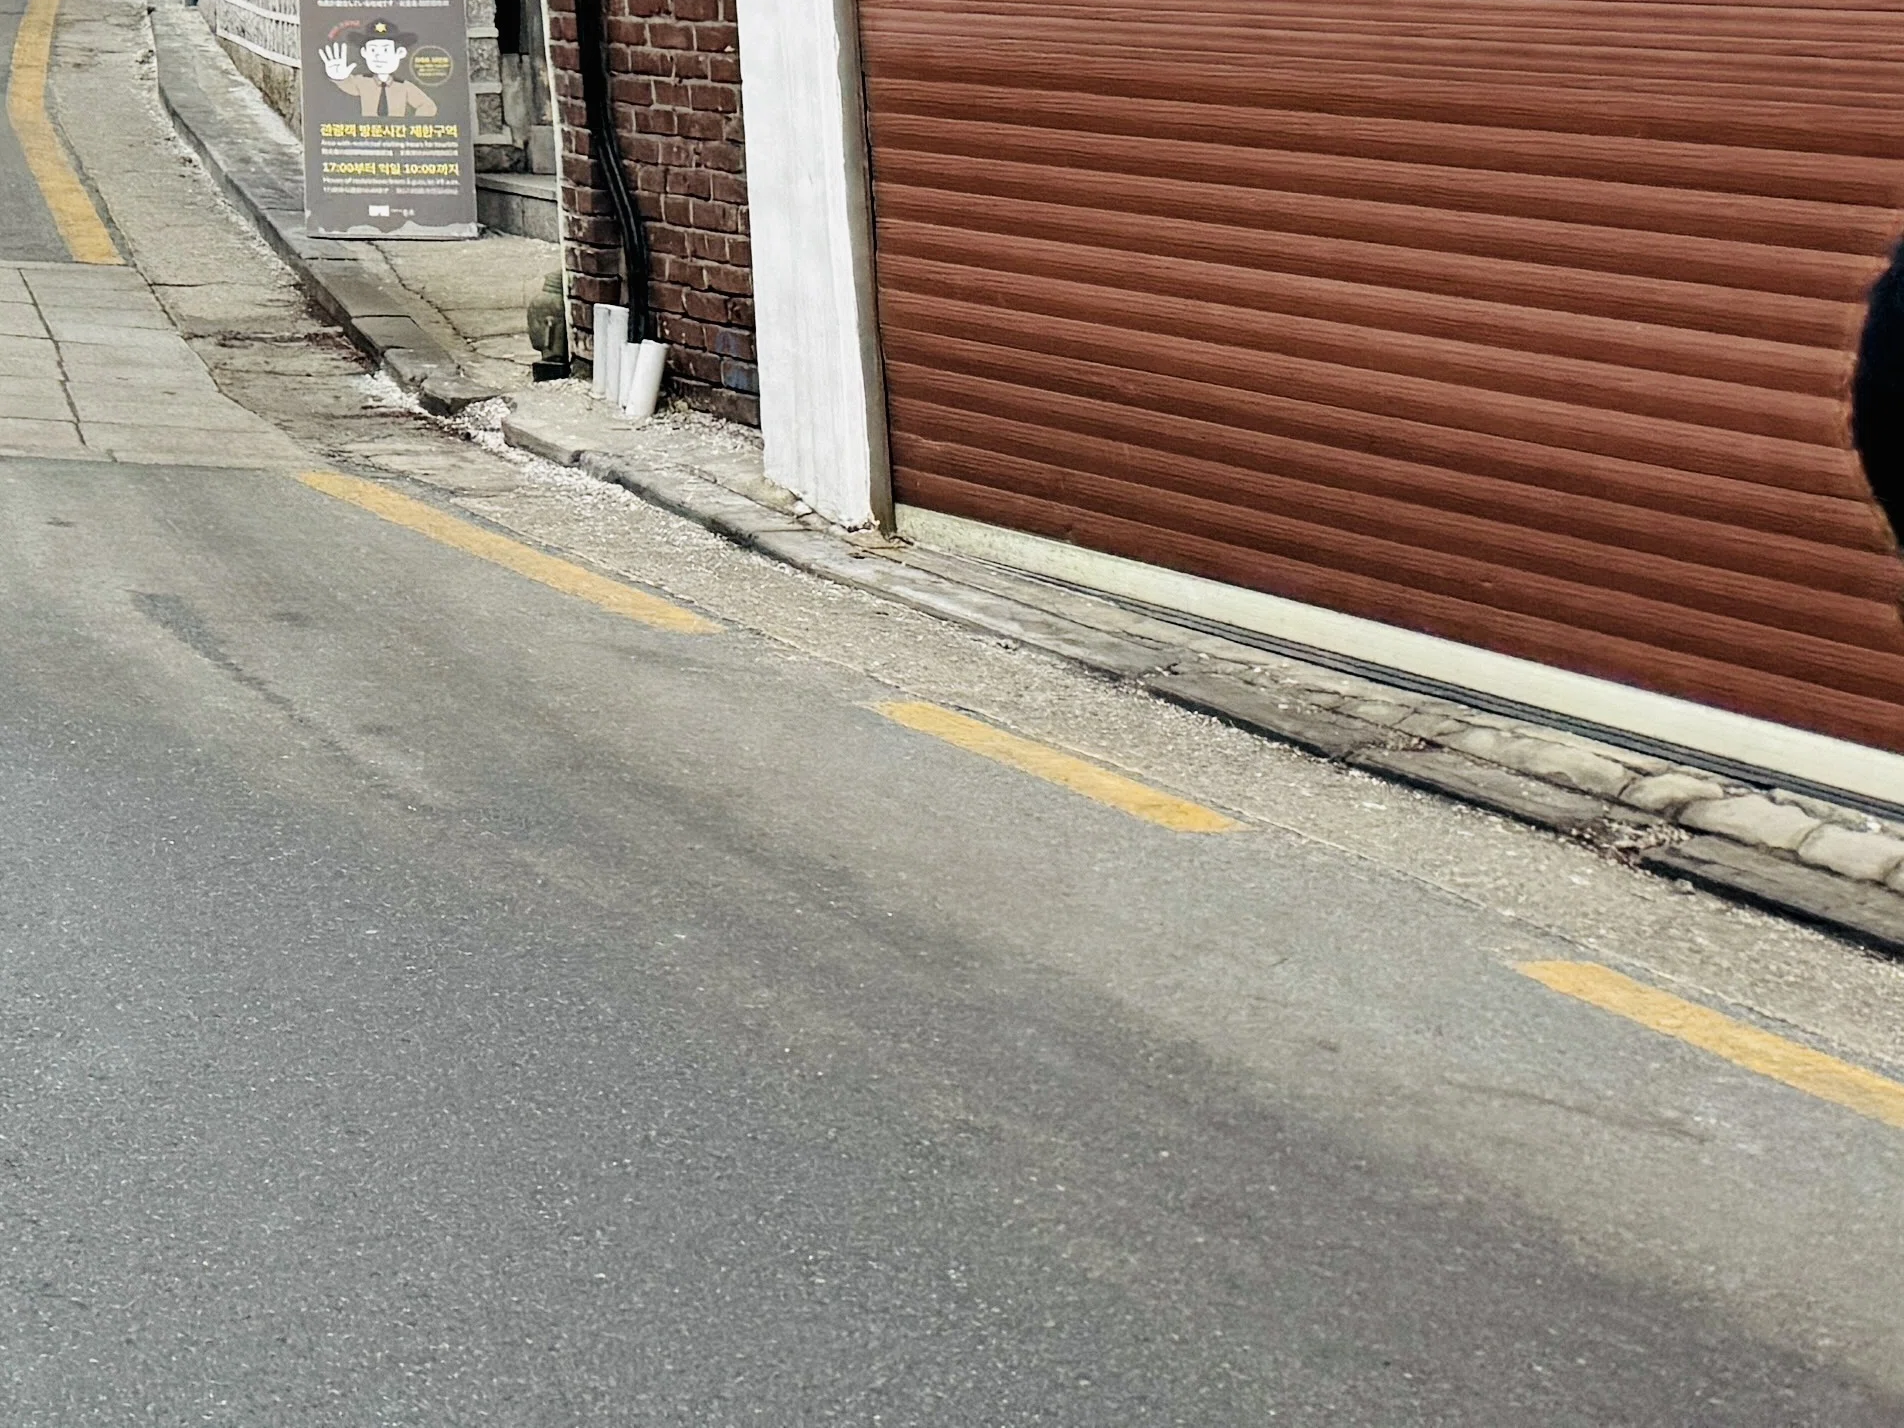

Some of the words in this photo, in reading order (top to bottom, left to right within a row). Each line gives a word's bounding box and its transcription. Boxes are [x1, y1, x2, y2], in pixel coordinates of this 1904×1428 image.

[320, 123, 356, 138] 관광객
[359, 124, 407, 139] 방문시간
[409, 124, 459, 139] 제한구역
[322, 162, 376, 175] 17:00부터
[403, 163, 460, 177] 10:00까지
